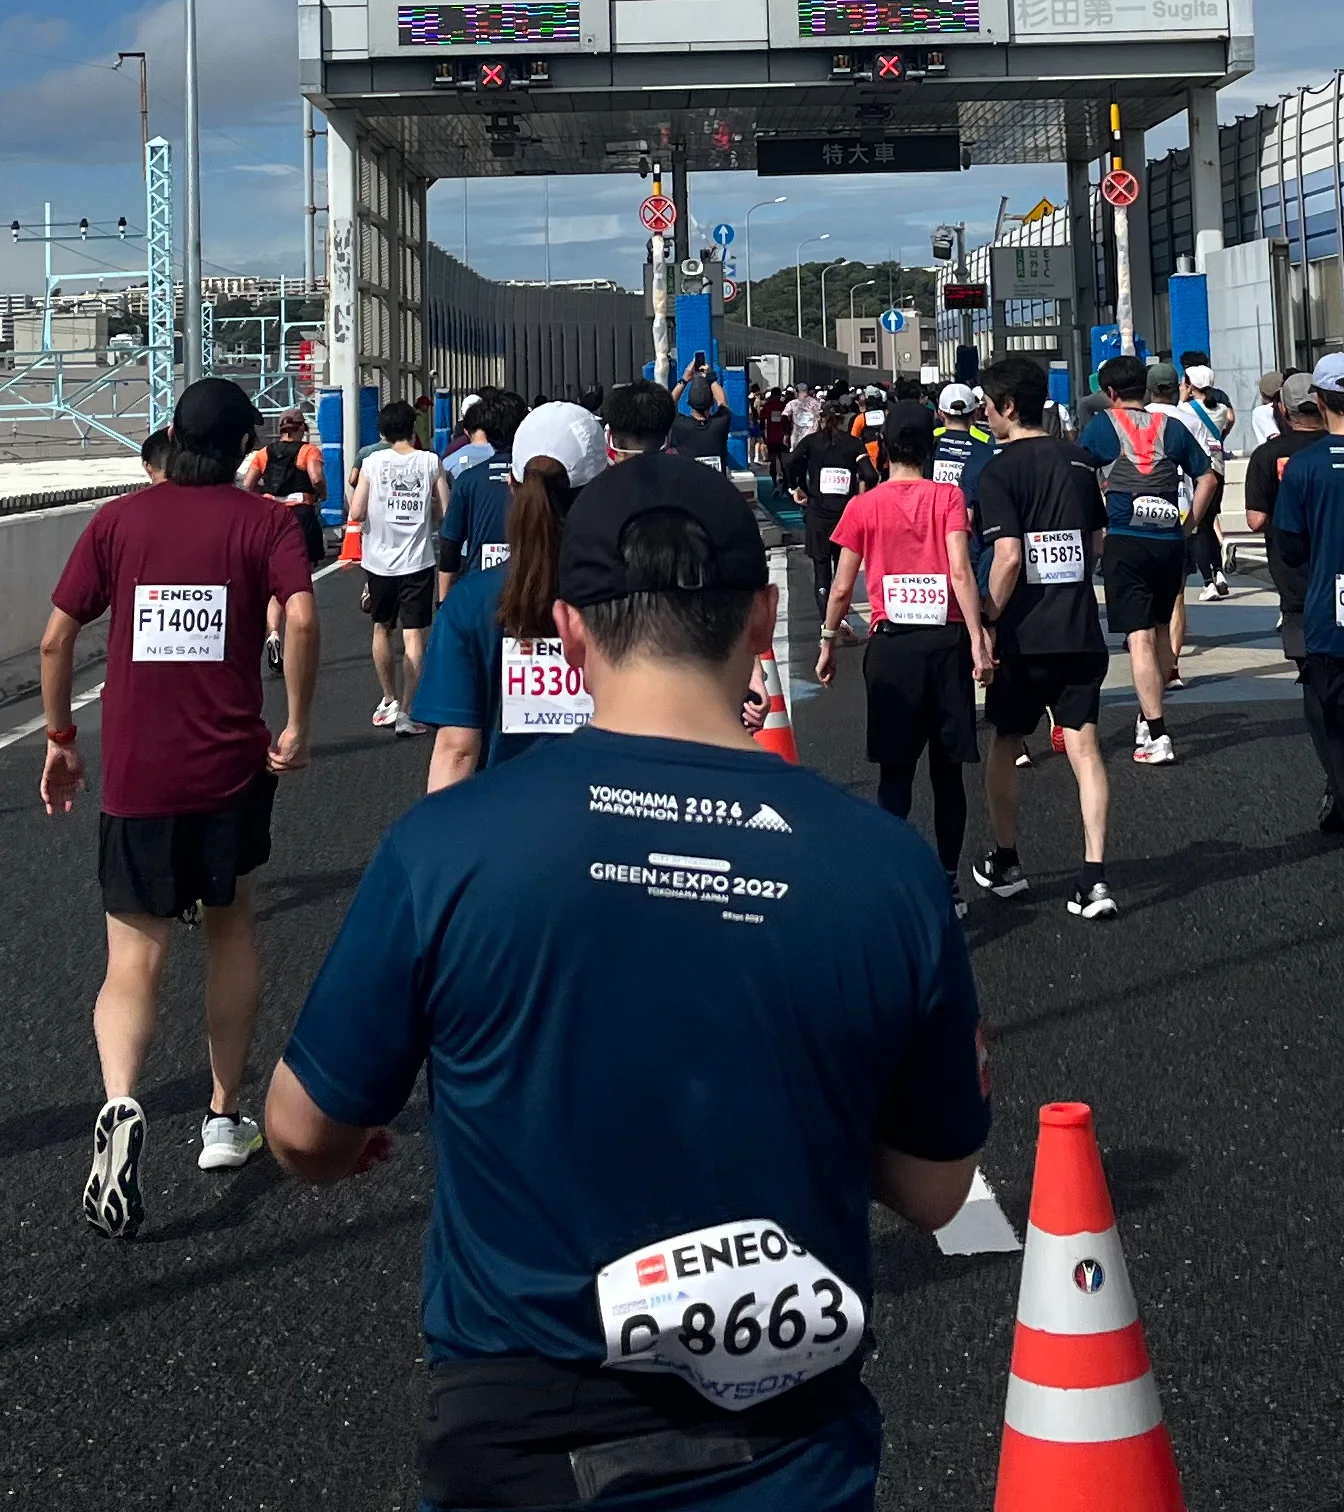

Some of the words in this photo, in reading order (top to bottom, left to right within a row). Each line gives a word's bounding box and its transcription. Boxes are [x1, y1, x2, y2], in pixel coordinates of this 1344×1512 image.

[1152, 0, 1218, 22] Sugita
[822, 142, 895, 165] 特大車
[1042, 533, 1074, 542] ENEOS
[1028, 546, 1082, 564] G15875
[160, 589, 213, 601] ENEOS
[887, 588, 946, 605] F32395
[138, 608, 224, 632] F14004
[146, 646, 210, 655] NISSAN
[589, 785, 679, 809] YOKOHAMA
[686, 797, 743, 819] 2026
[589, 800, 679, 823] MARATHON
[647, 886, 698, 900] YOKOHAMA
[700, 892, 729, 904] JAPAN
[733, 877, 789, 900] 2027
